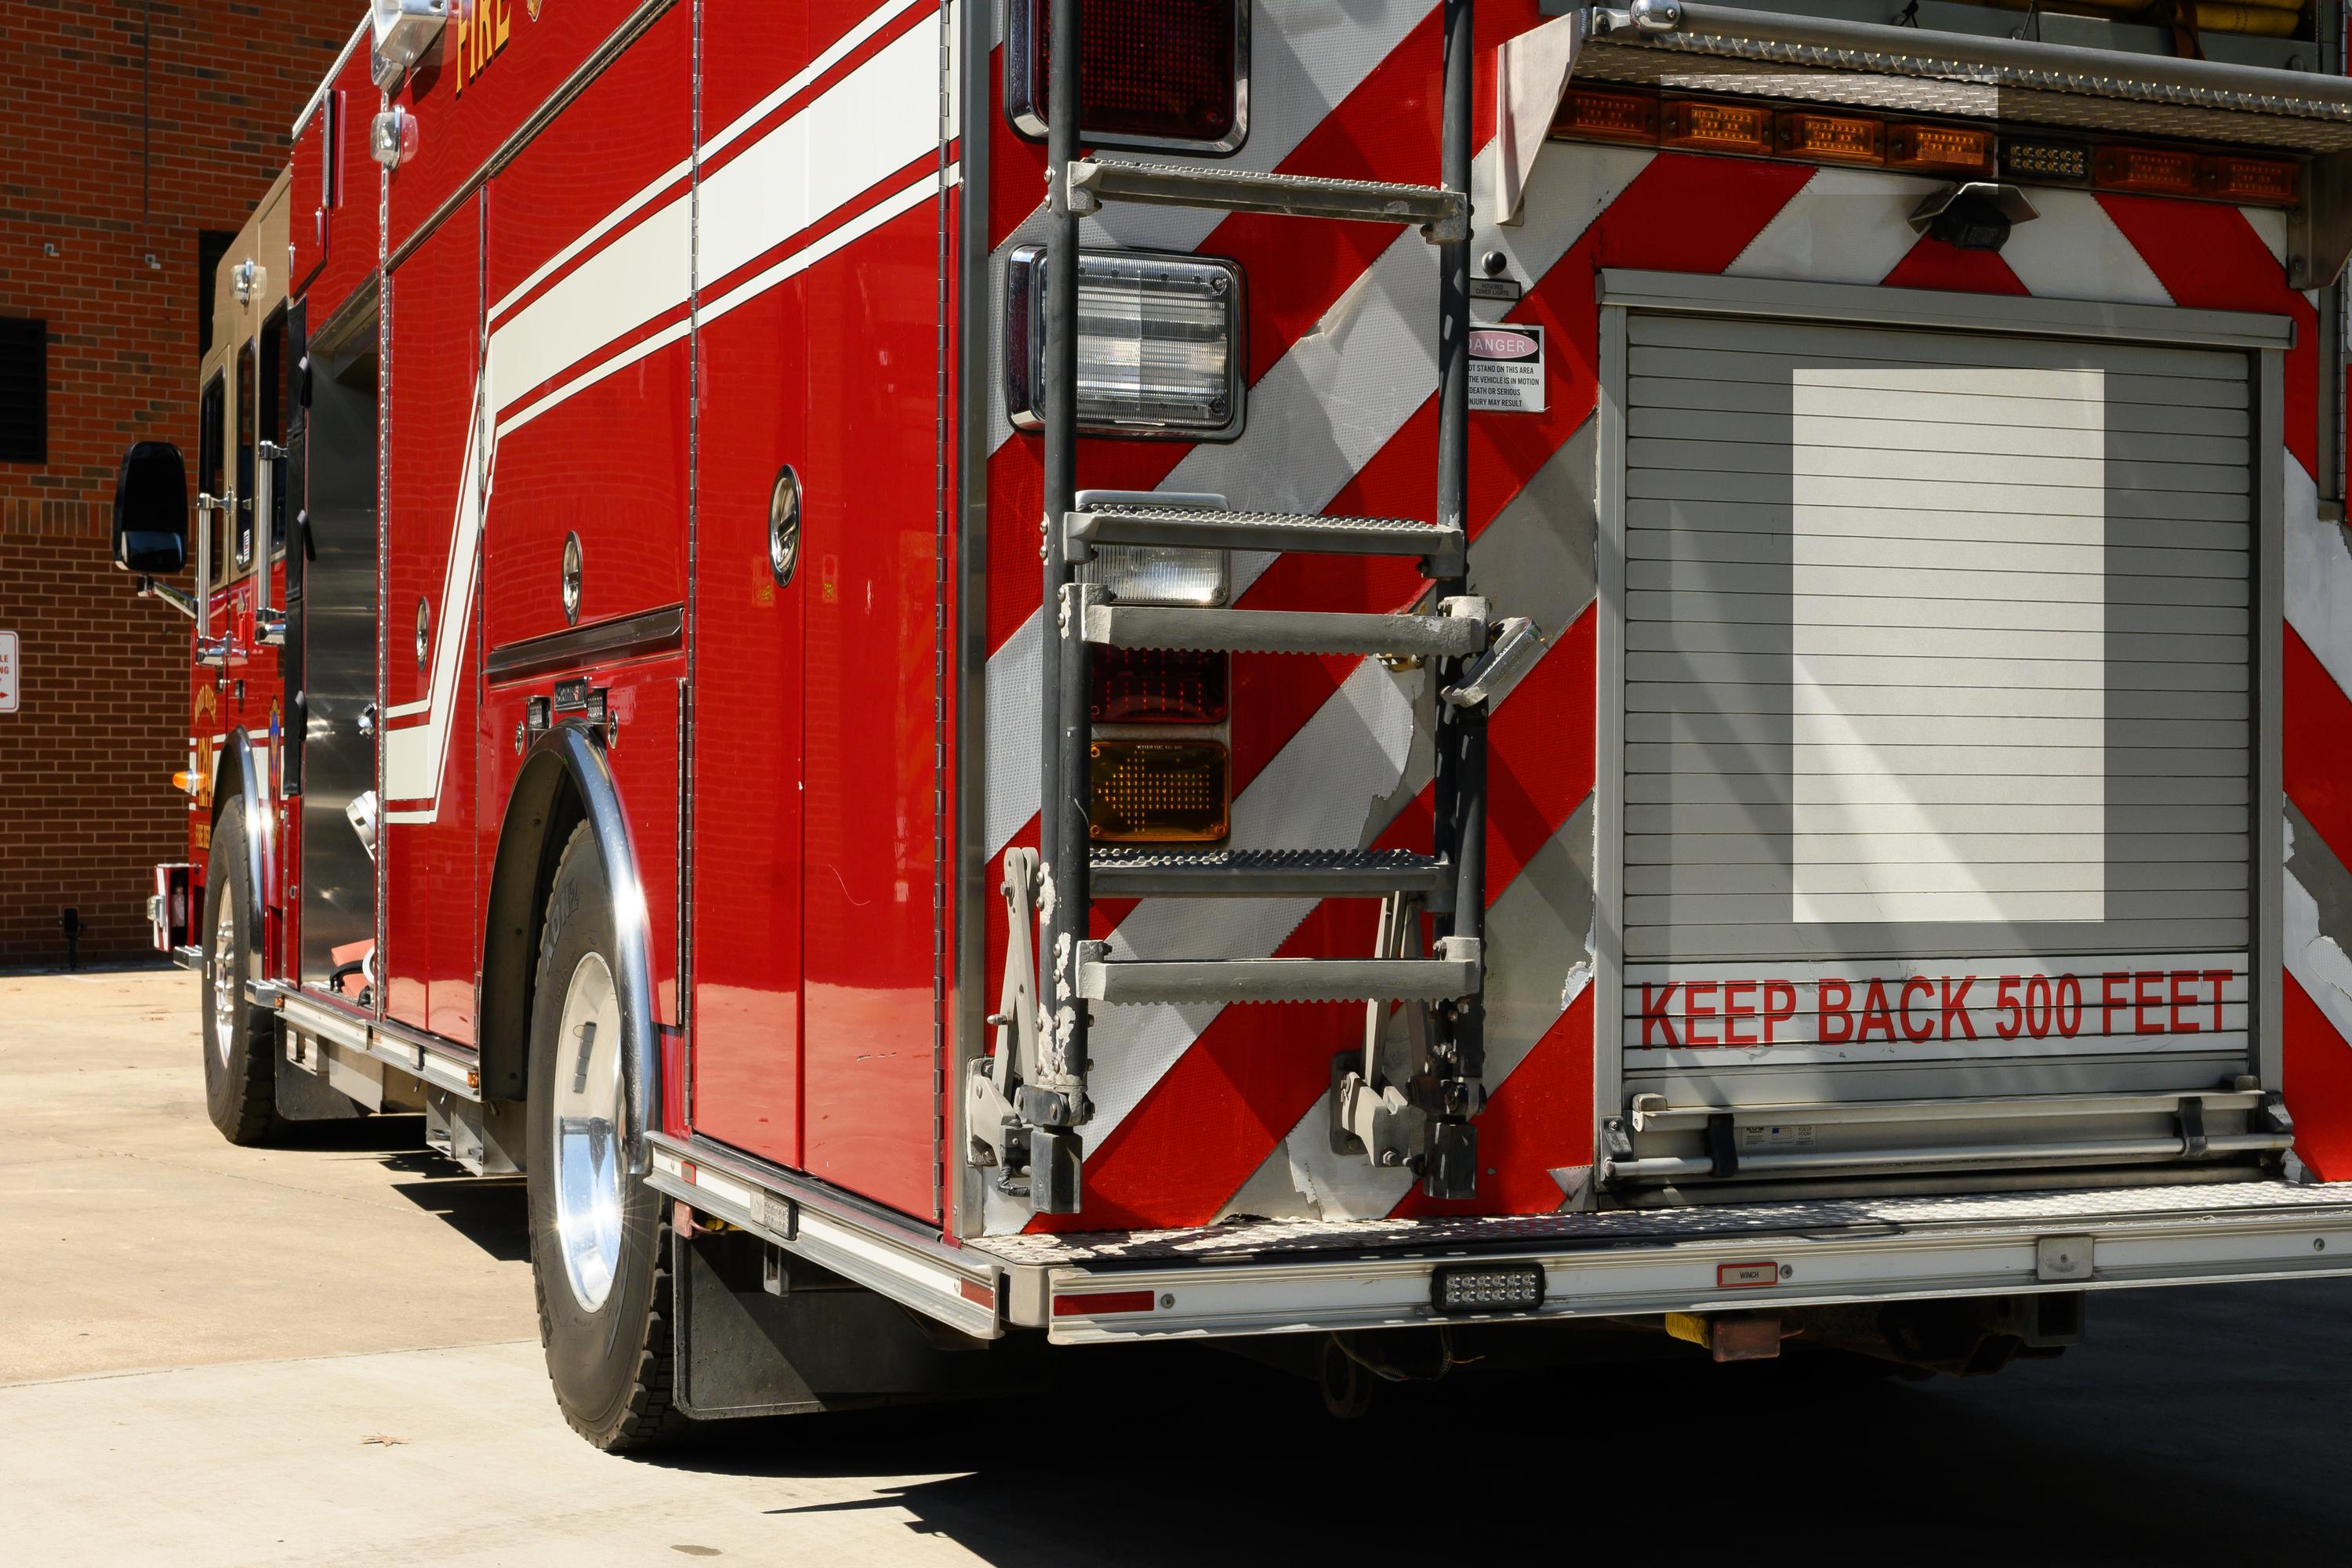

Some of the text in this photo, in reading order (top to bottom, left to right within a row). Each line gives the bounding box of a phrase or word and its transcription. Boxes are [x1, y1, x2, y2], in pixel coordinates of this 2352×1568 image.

[1480, 376, 1503, 384] VEHICLE
[1469, 397, 1489, 406] NJURY
[1641, 969, 2234, 1051] KEEP BACK 500 FEET
[1739, 1271, 1759, 1279] WINCH
